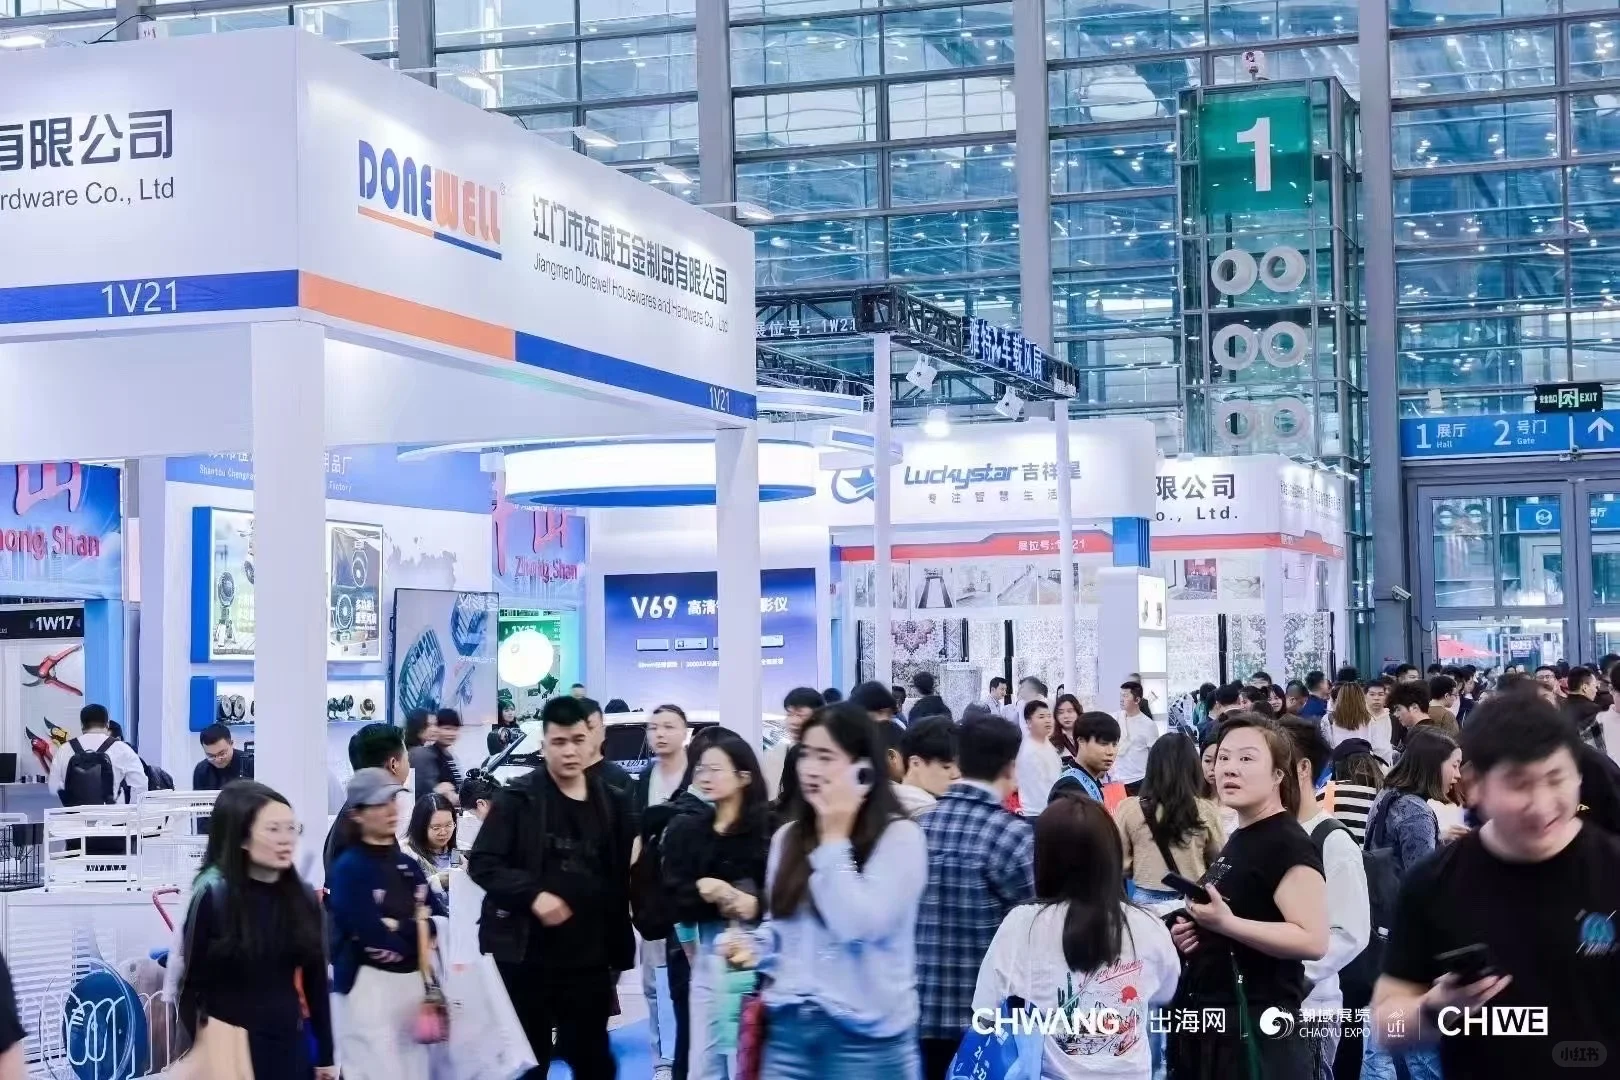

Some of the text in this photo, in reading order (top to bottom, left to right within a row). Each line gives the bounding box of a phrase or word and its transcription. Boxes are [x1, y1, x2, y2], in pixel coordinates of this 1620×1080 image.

[1237, 117, 1271, 192] 1
[85, 181, 131, 205] Co.,
[139, 176, 174, 201] Ltd
[358, 139, 501, 245] DONEWELL
[532, 193, 728, 304] 江门市东威五金制品有限公司
[101, 280, 178, 315] 1V21
[534, 253, 574, 280] Jiangmen
[575, 266, 611, 295] Donewell
[612, 280, 657, 311] Housewares
[657, 298, 671, 315] and
[672, 304, 704, 325] Hardware
[709, 386, 730, 412] 1V21
[1580, 392, 1598, 402] EXIT
[1416, 419, 1547, 449] 1 展厅 2 号门
[1436, 440, 1453, 448] Hall
[1517, 437, 1535, 445] Gate
[904, 463, 1018, 490] Luckystar
[1155, 473, 1235, 501] 限公司
[1197, 506, 1238, 520] Ltd.
[52, 525, 99, 557] Shan
[1018, 539, 1085, 552] 展位号:121
[552, 559, 578, 580] Shan
[632, 596, 677, 619] V69
[687, 599, 719, 616] 高清
[36, 615, 75, 631] 1W17
